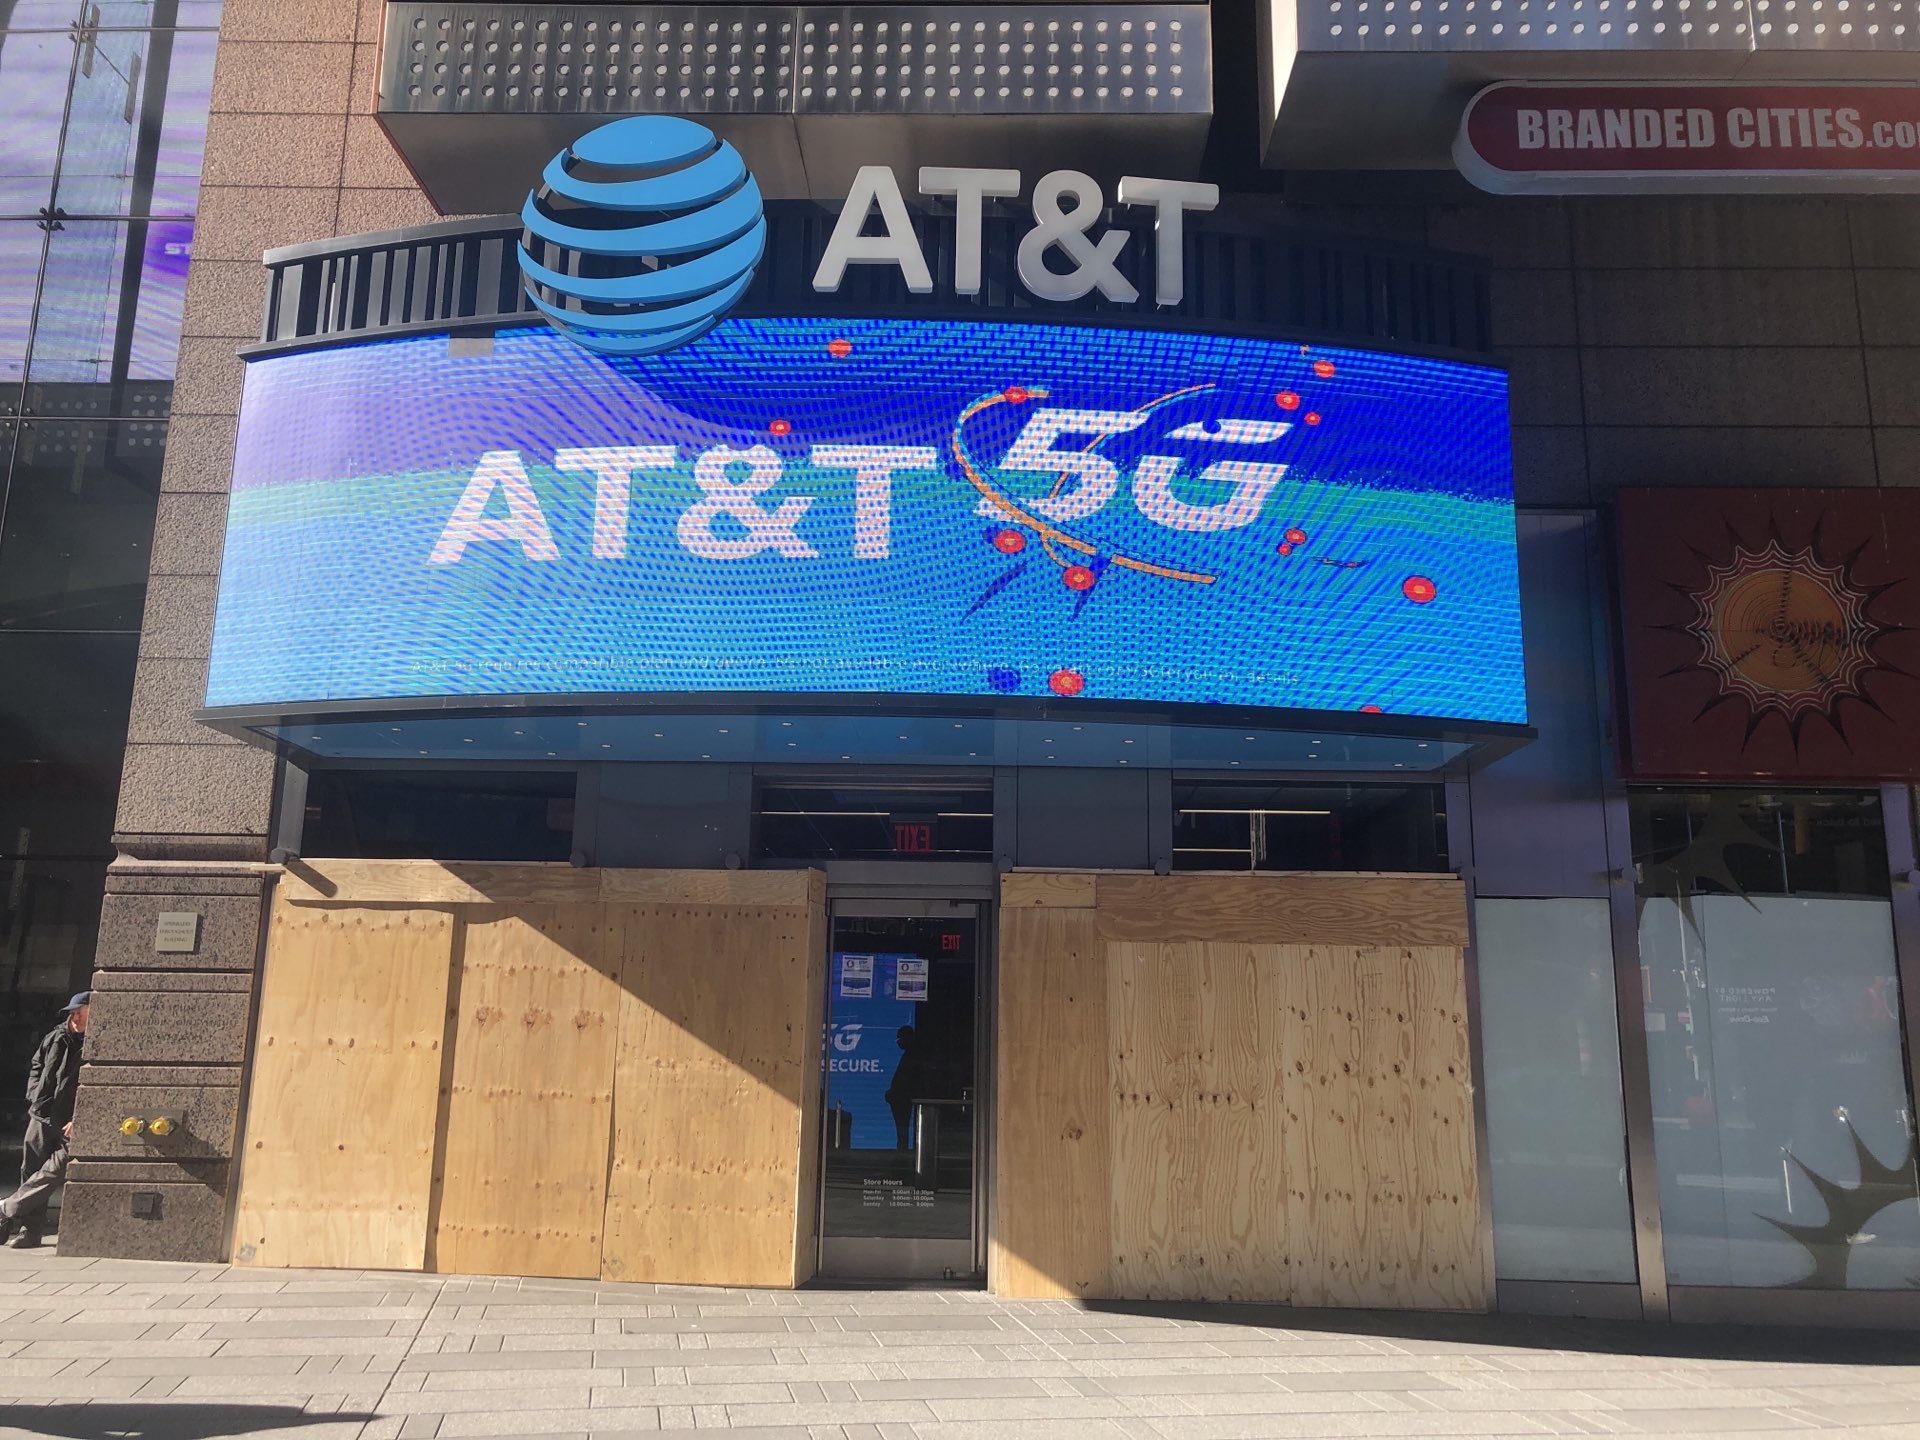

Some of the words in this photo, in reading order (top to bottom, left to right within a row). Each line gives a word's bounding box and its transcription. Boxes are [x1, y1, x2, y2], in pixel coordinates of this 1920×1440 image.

[1516, 107, 1715, 150] BRANDED
[812, 165, 1220, 306] AT&T
[426, 443, 938, 566] AT&T
[974, 406, 1294, 533] 5G
[942, 934, 961, 950] EXIT
[863, 1178, 882, 1186] Store
[883, 1178, 903, 1186] Hours
